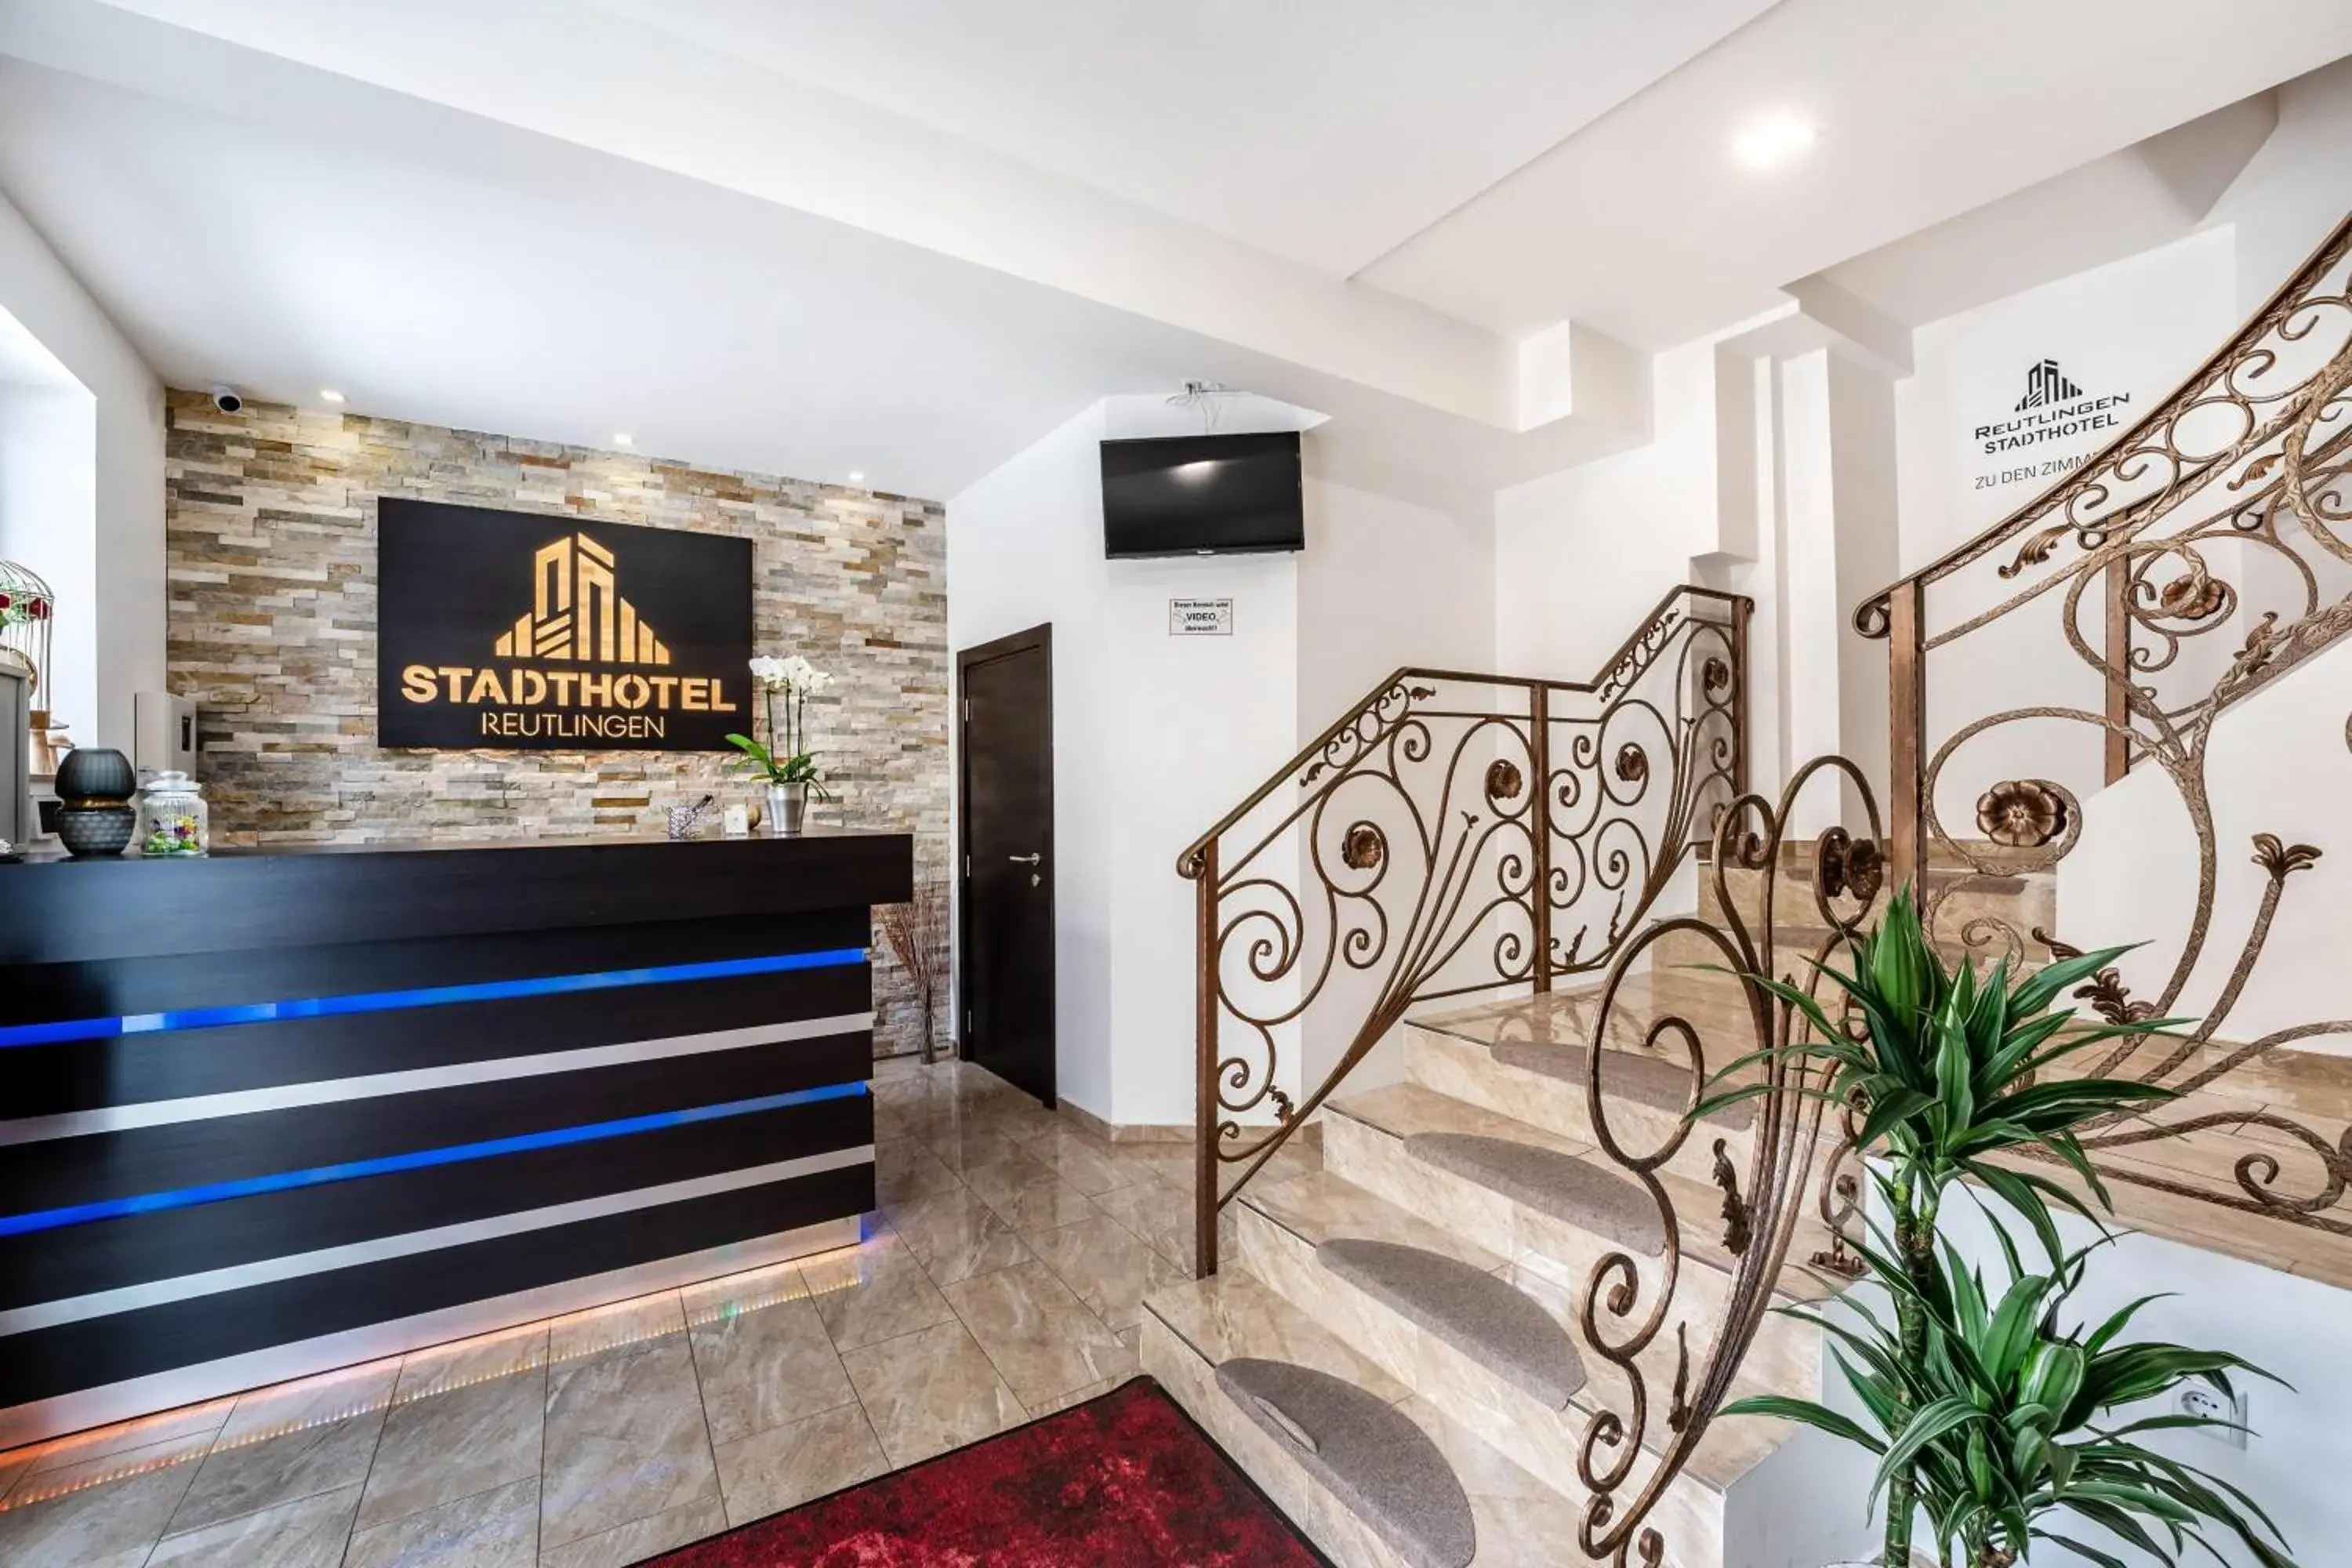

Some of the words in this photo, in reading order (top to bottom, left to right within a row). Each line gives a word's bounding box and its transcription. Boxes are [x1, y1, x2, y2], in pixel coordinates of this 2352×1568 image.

[1975, 393, 2129, 439] REUTLINGEN
[1984, 413, 2119, 454] STADTHOTEL
[1975, 475, 1996, 490] ZU
[2002, 465, 2036, 484] DEN
[2041, 452, 2099, 476] ZIMM
[1186, 612, 1216, 622] VIDEO
[401, 665, 736, 712] STADTHOTEL
[482, 712, 664, 738] REUTLINGEN
